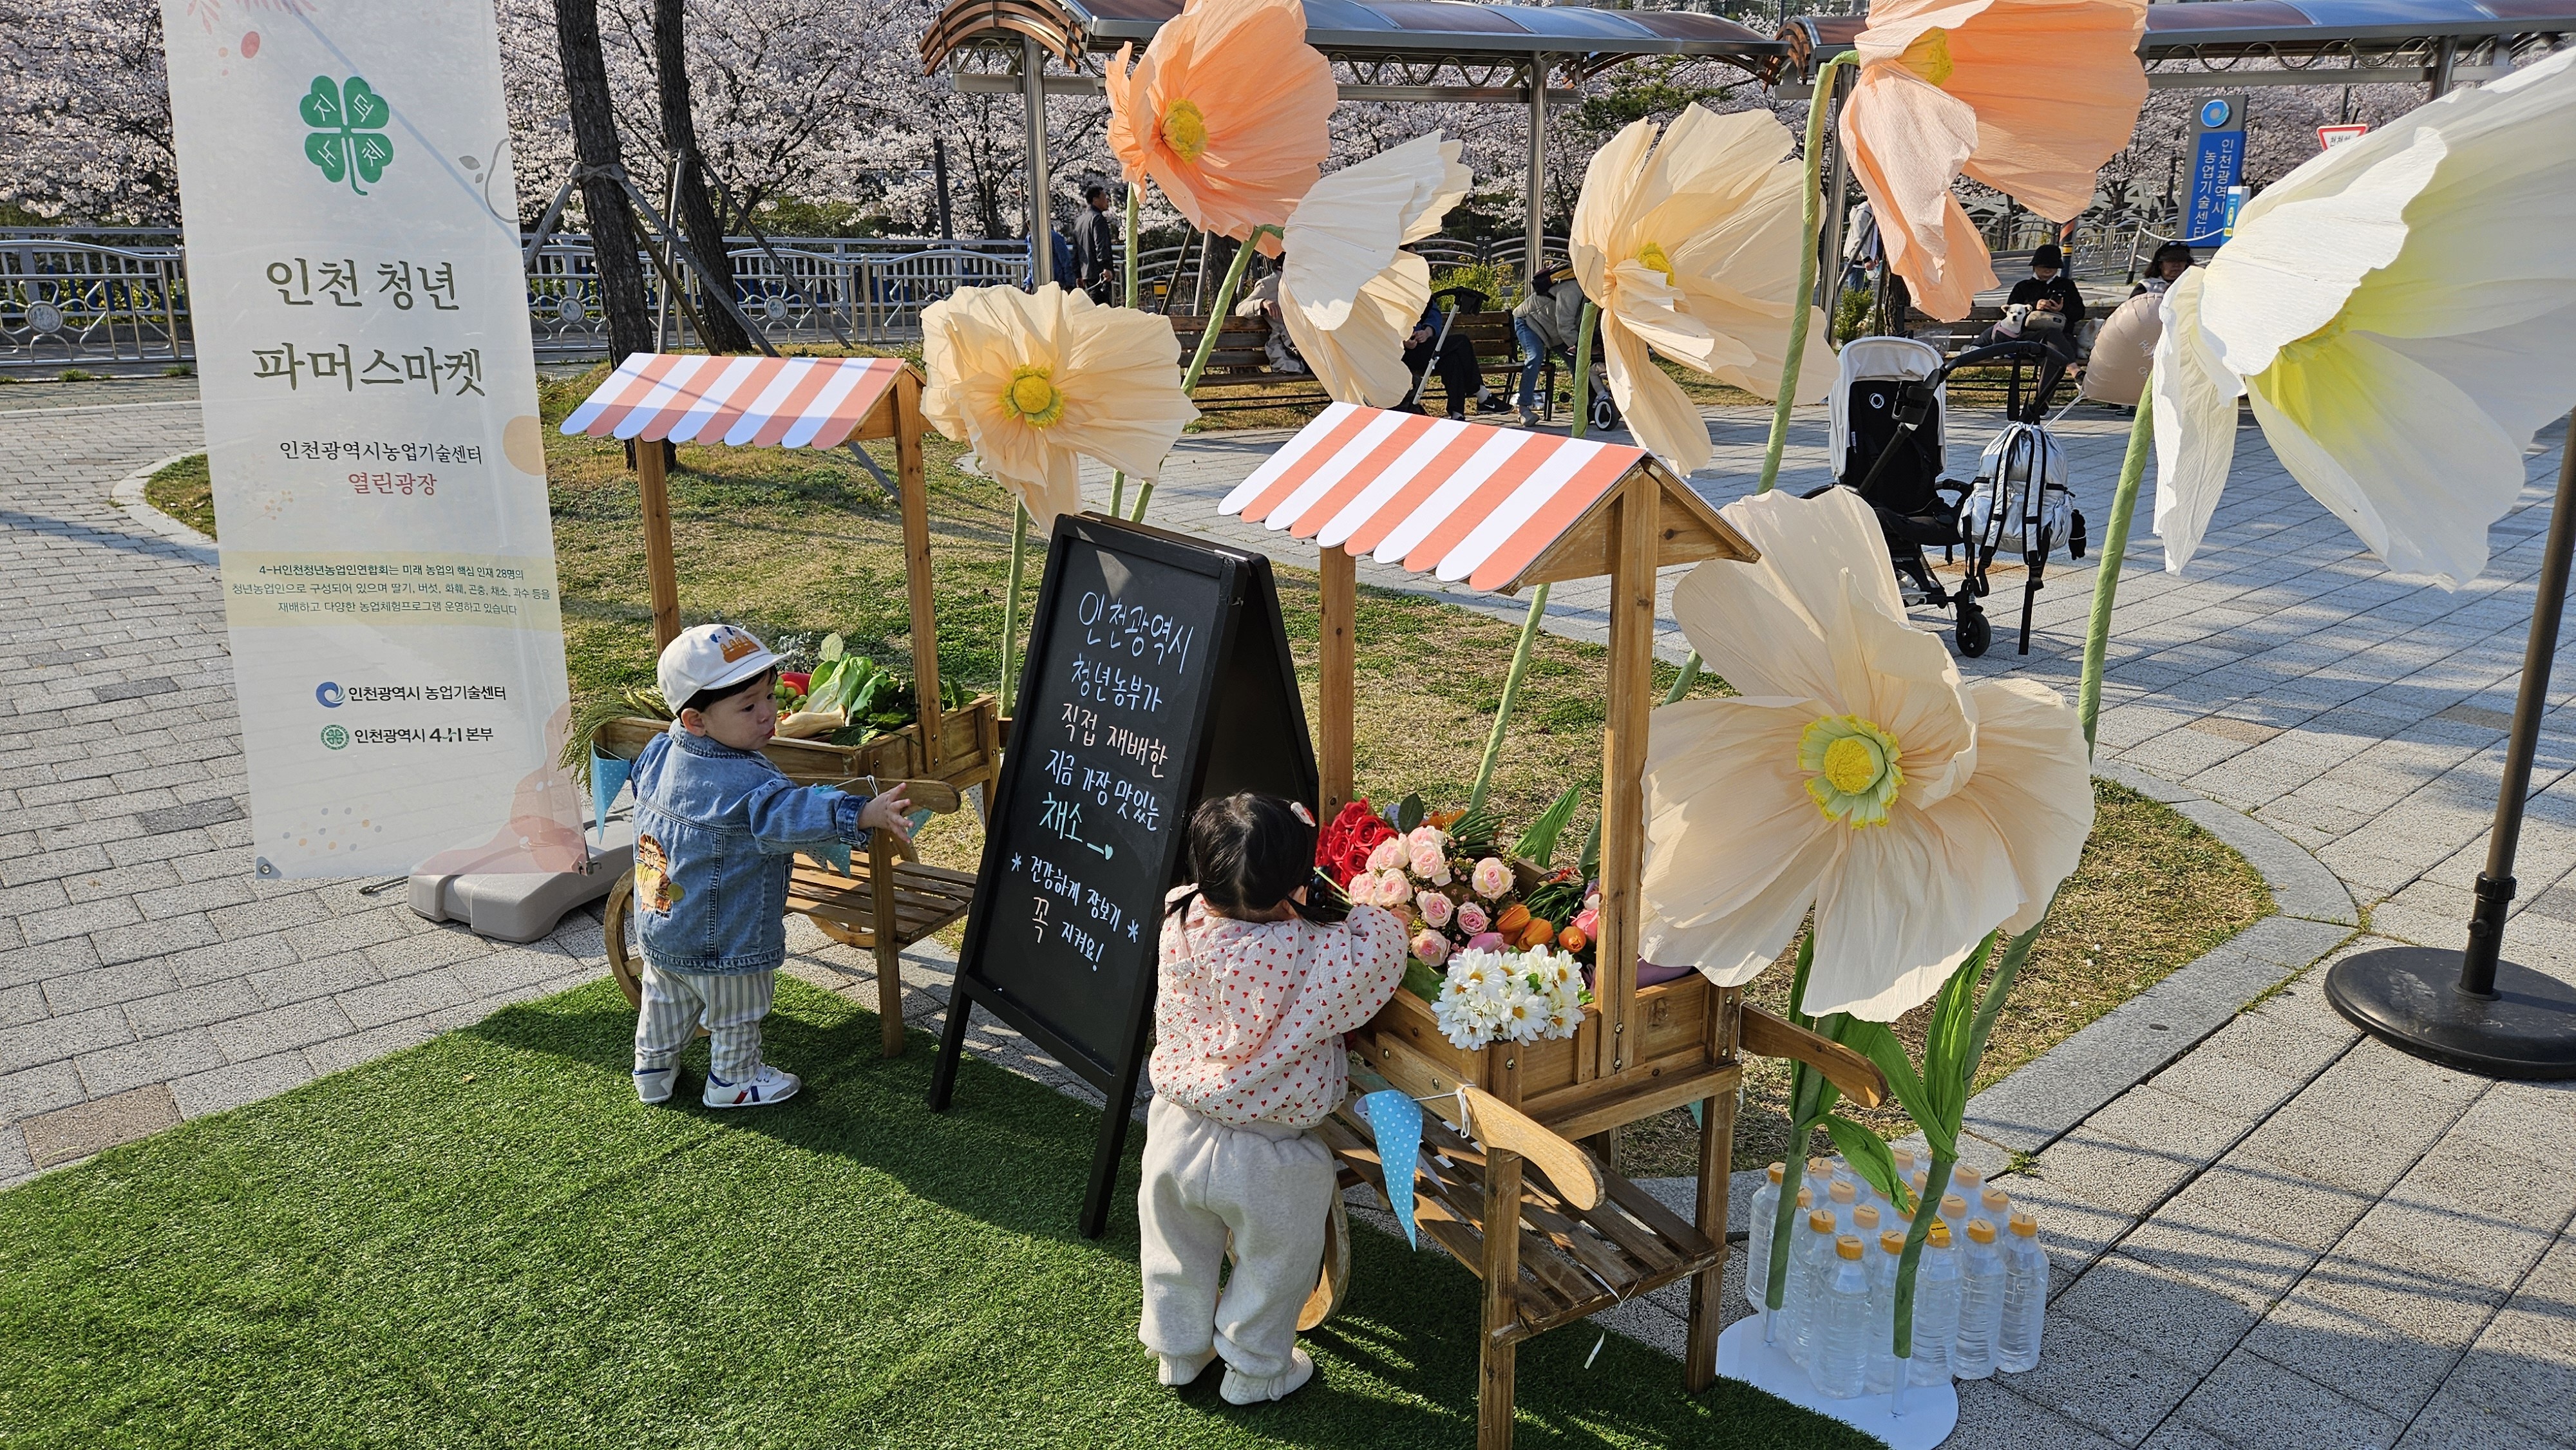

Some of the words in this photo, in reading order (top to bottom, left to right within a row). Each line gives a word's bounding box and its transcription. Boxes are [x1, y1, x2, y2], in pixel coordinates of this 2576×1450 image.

[2193, 149, 2217, 238] 농업기술센터
[2211, 138, 2234, 215] 인천광역시
[266, 258, 363, 306] 인천
[377, 260, 460, 310] 청년
[252, 342, 486, 397] 파머스마켓
[279, 440, 482, 465] 인천광역시농업기술센터
[348, 472, 438, 496] 열린광장
[232, 583, 307, 594] 청년농업인으로
[310, 583, 352, 594] 구성되어
[356, 583, 388, 594] 있으며
[392, 583, 415, 594] 딸기,
[419, 583, 441, 594] 버섯,
[468, 585, 488, 596] 곤충,
[491, 586, 511, 598] 채소,
[513, 587, 530, 599] 과수
[532, 588, 551, 600] 등을
[259, 565, 399, 576] 4-H인천청년농업인연합회는
[402, 565, 422, 575] 미래
[426, 565, 455, 576] 농업의
[457, 566, 475, 576] 핵심
[477, 567, 494, 578] 인재
[496, 569, 524, 580] 28명의
[278, 602, 321, 613] 재배하고
[325, 601, 356, 612] 다양한
[359, 601, 441, 612] 농업체험프로그램
[445, 601, 481, 612] 운영하고
[484, 603, 517, 615] 있습니다
[1079, 591, 1193, 675] 인천광역시
[348, 686, 420, 702] 인천광역시
[424, 685, 506, 701] 농업기술센터
[1071, 652, 1162, 712] 청년농부가
[354, 729, 425, 744] 인천광역시
[466, 728, 493, 741] 본부
[1061, 703, 1097, 747] 직접
[1106, 726, 1168, 778] 재배한
[1045, 749, 1075, 786] 지금
[1082, 767, 1112, 805] 가장
[1114, 780, 1159, 831] 맛있는
[1039, 791, 1083, 843] 채소
[1030, 856, 1081, 906] 건강하게
[1086, 889, 1121, 932] 장보기
[1032, 896, 1050, 944] 꼭
[1061, 921, 1104, 972] 지켜요!
